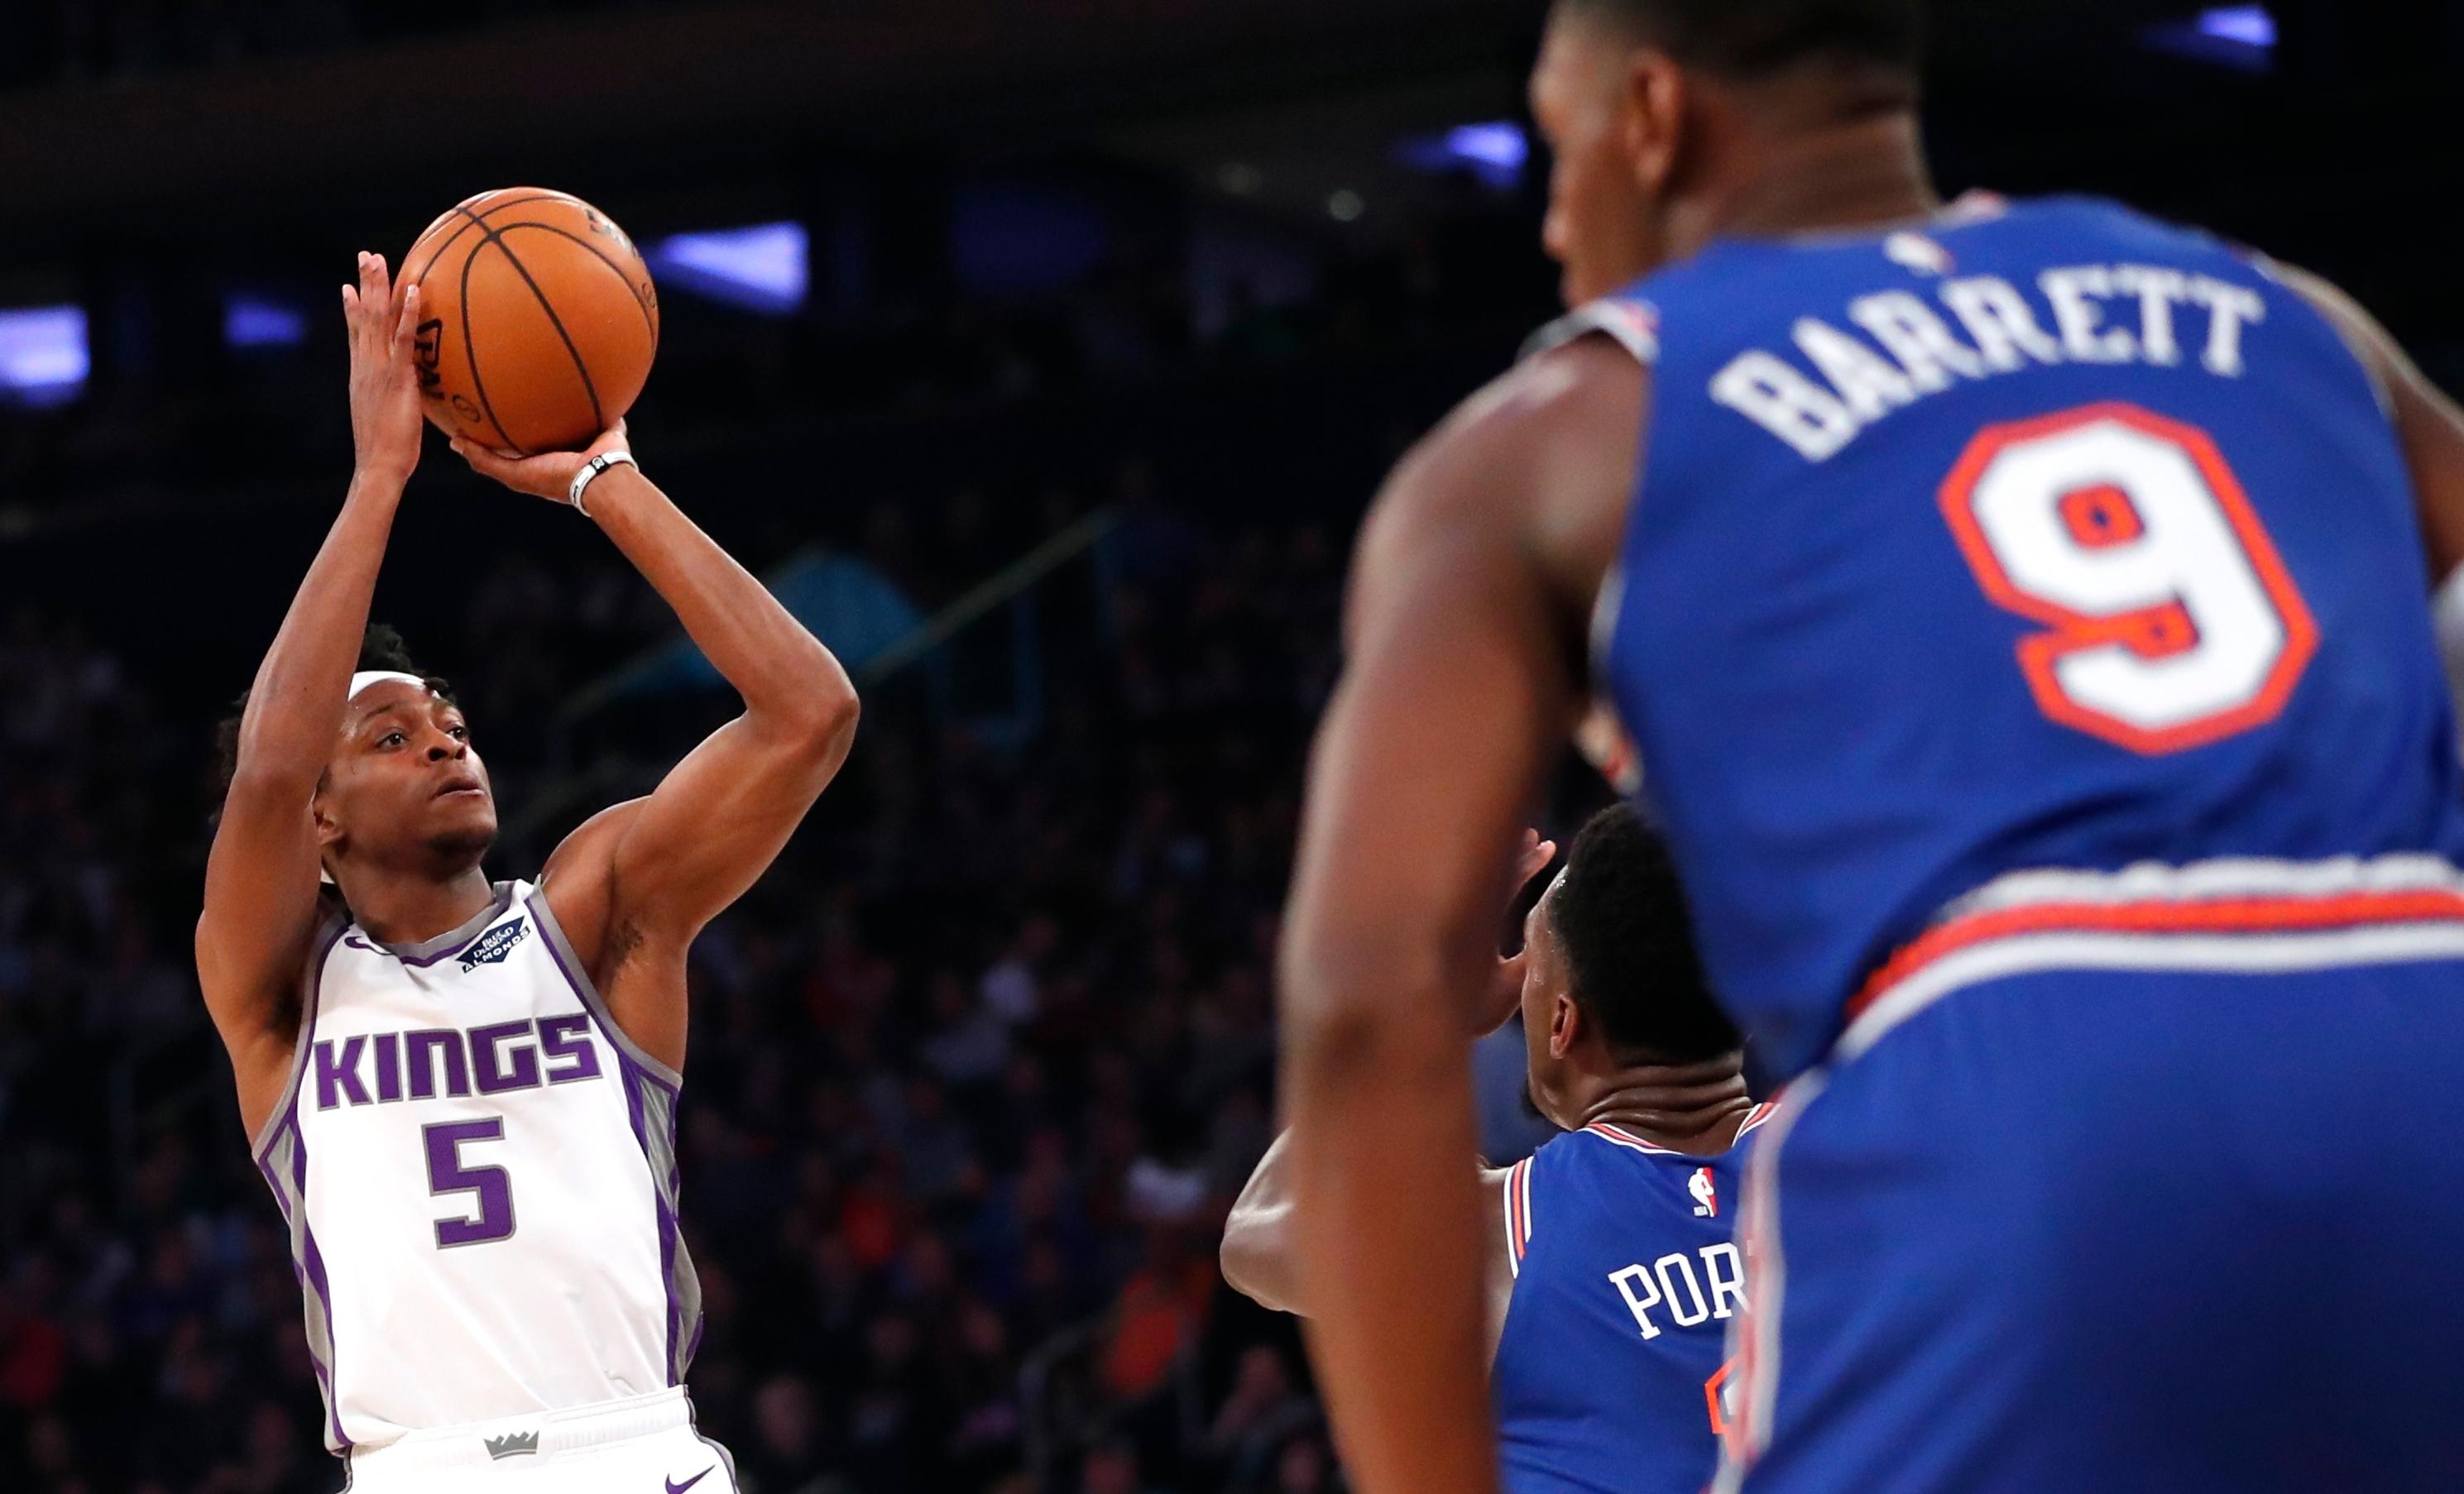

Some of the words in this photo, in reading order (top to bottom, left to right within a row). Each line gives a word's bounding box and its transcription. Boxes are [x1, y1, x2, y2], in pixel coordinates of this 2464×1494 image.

[1708, 262, 2267, 464] BARRETT
[1937, 401, 2320, 755] 9
[465, 927, 530, 971] ALMONDS
[313, 1012, 603, 1112] KINGS
[420, 1115, 517, 1250] 5
[1608, 1241, 1752, 1340] POR
